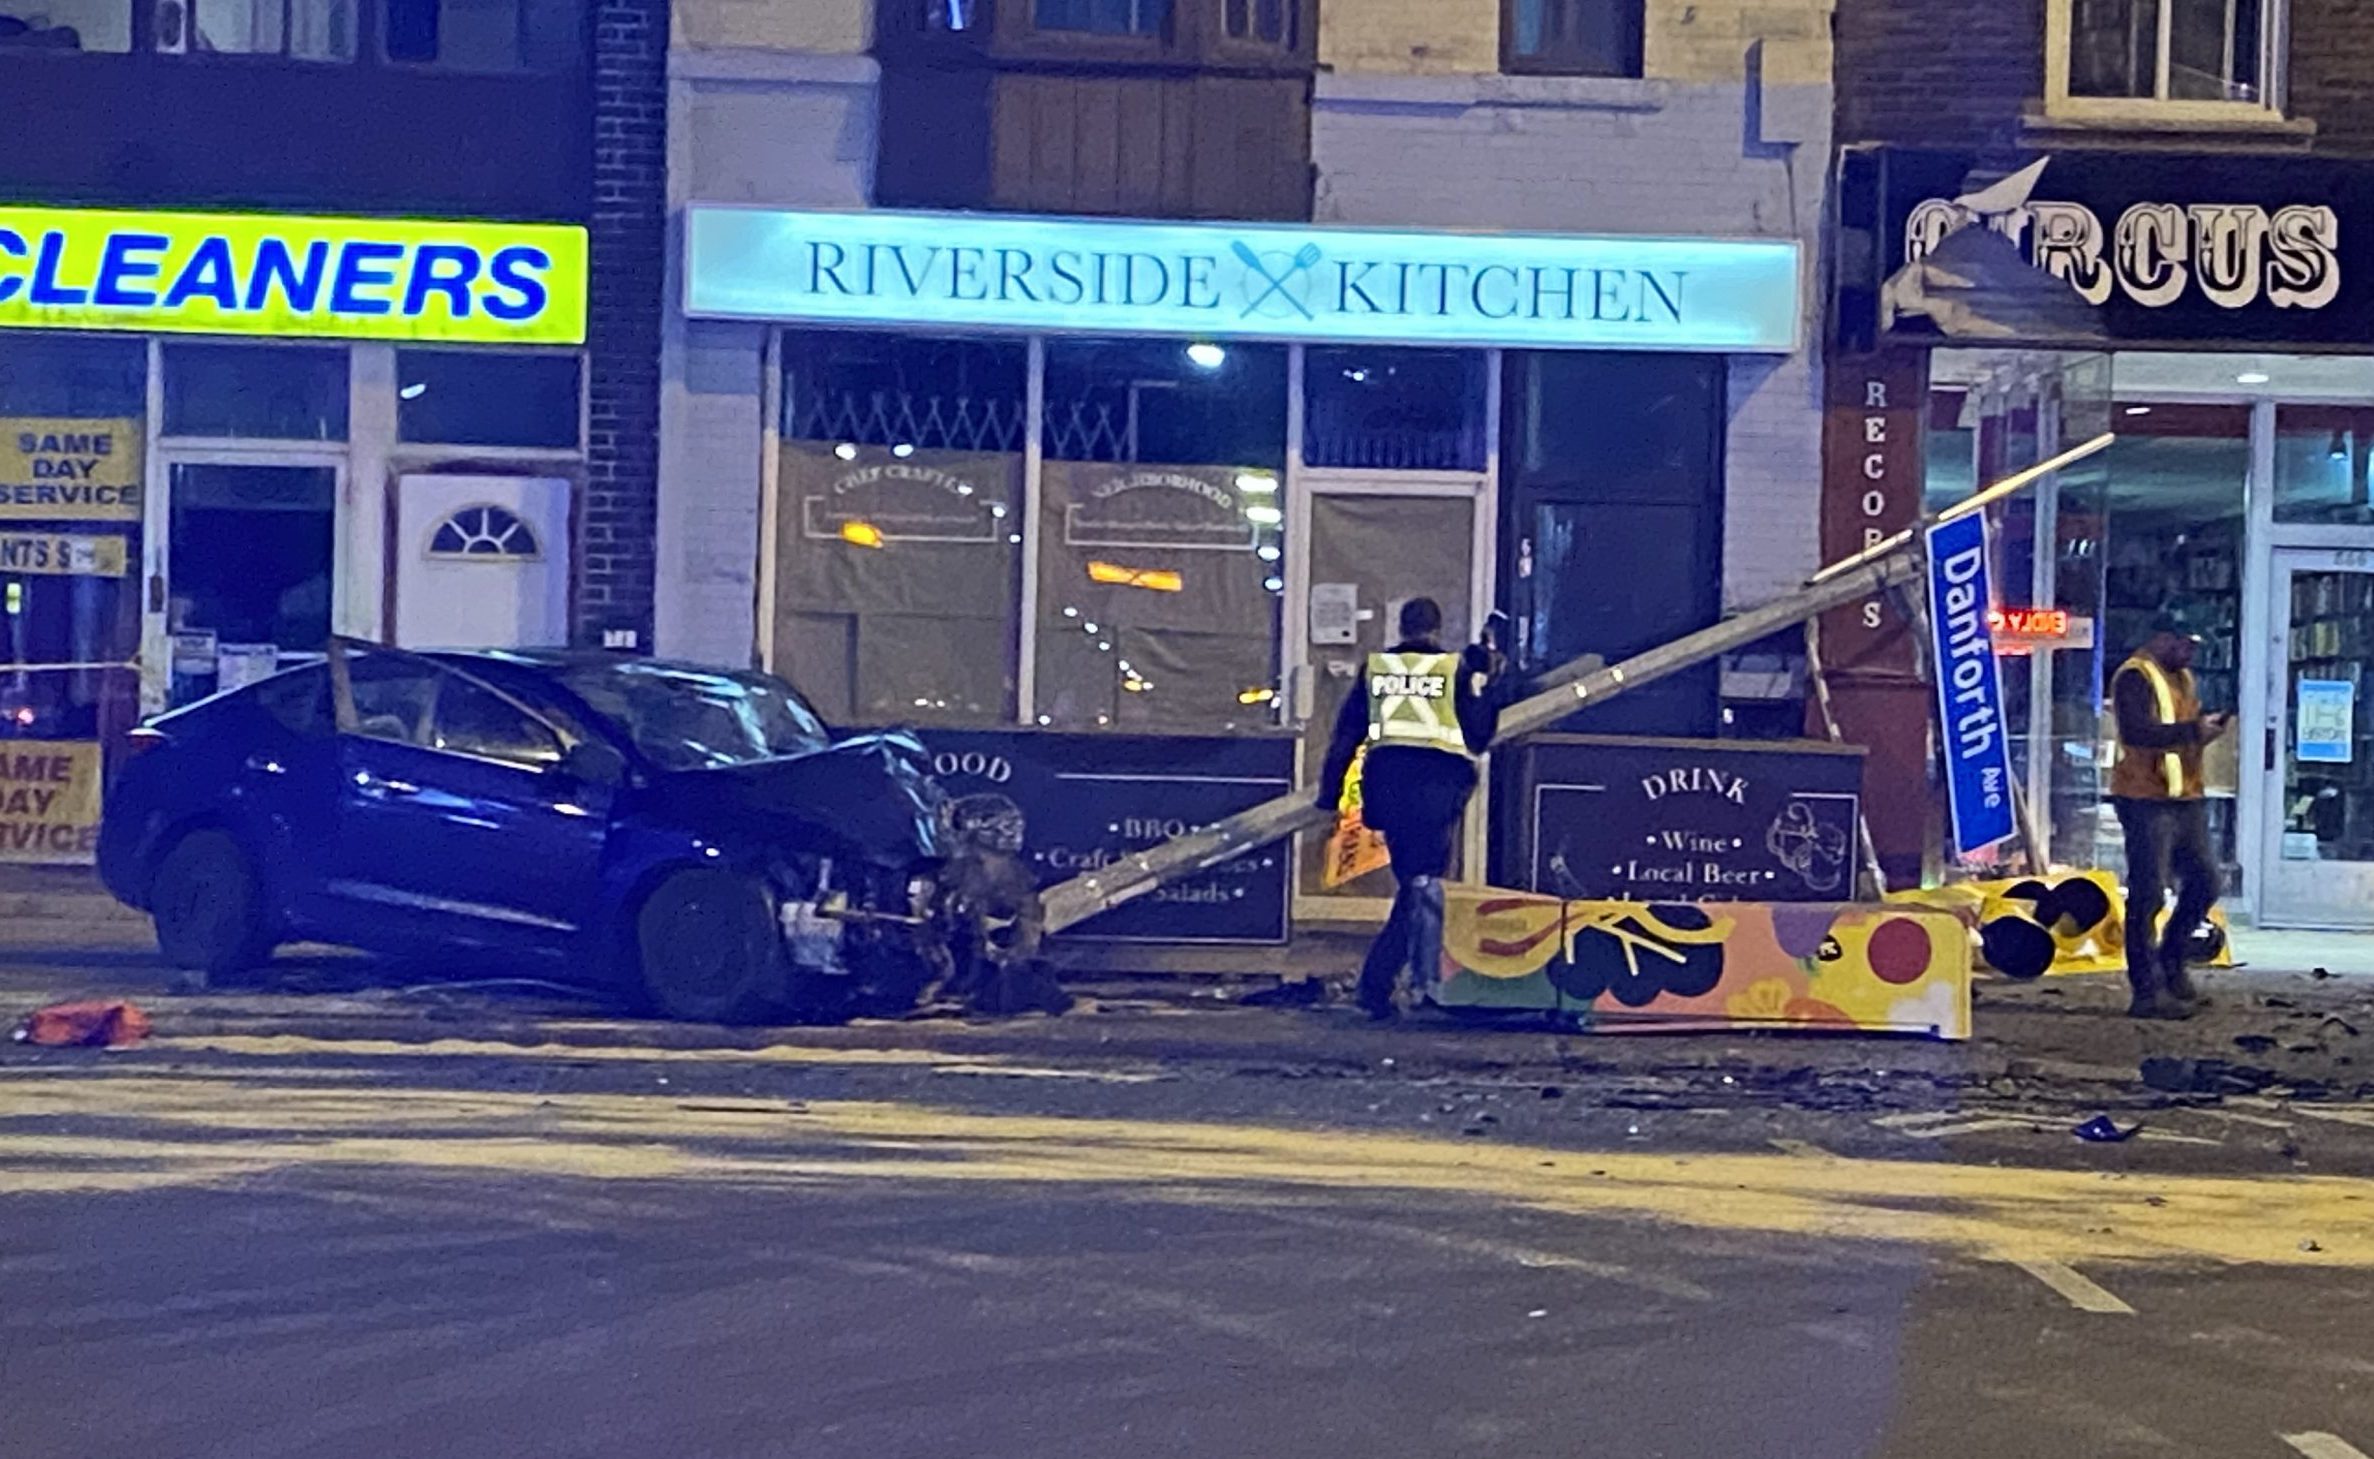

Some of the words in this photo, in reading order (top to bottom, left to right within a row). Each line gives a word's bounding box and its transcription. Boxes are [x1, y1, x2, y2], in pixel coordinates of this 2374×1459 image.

[1906, 198, 2340, 309] RCUS
[805, 240, 1221, 309] RIVERSIDE
[1332, 260, 1690, 324] KITCHEN
[18, 432, 112, 455] SAME
[33, 458, 100, 480] DAY
[0, 484, 138, 505] SERVICE
[1862, 376, 1890, 628] RECORS
[1943, 545, 1999, 760] Danforth
[1371, 673, 1445, 698] POLICE
[934, 751, 1013, 783] OOD
[1642, 767, 1750, 805] DRINK
[0, 789, 56, 816] AY
[1661, 831, 1728, 853] Wine
[1628, 860, 1693, 884] Local
[1703, 862, 1760, 885] Beer
